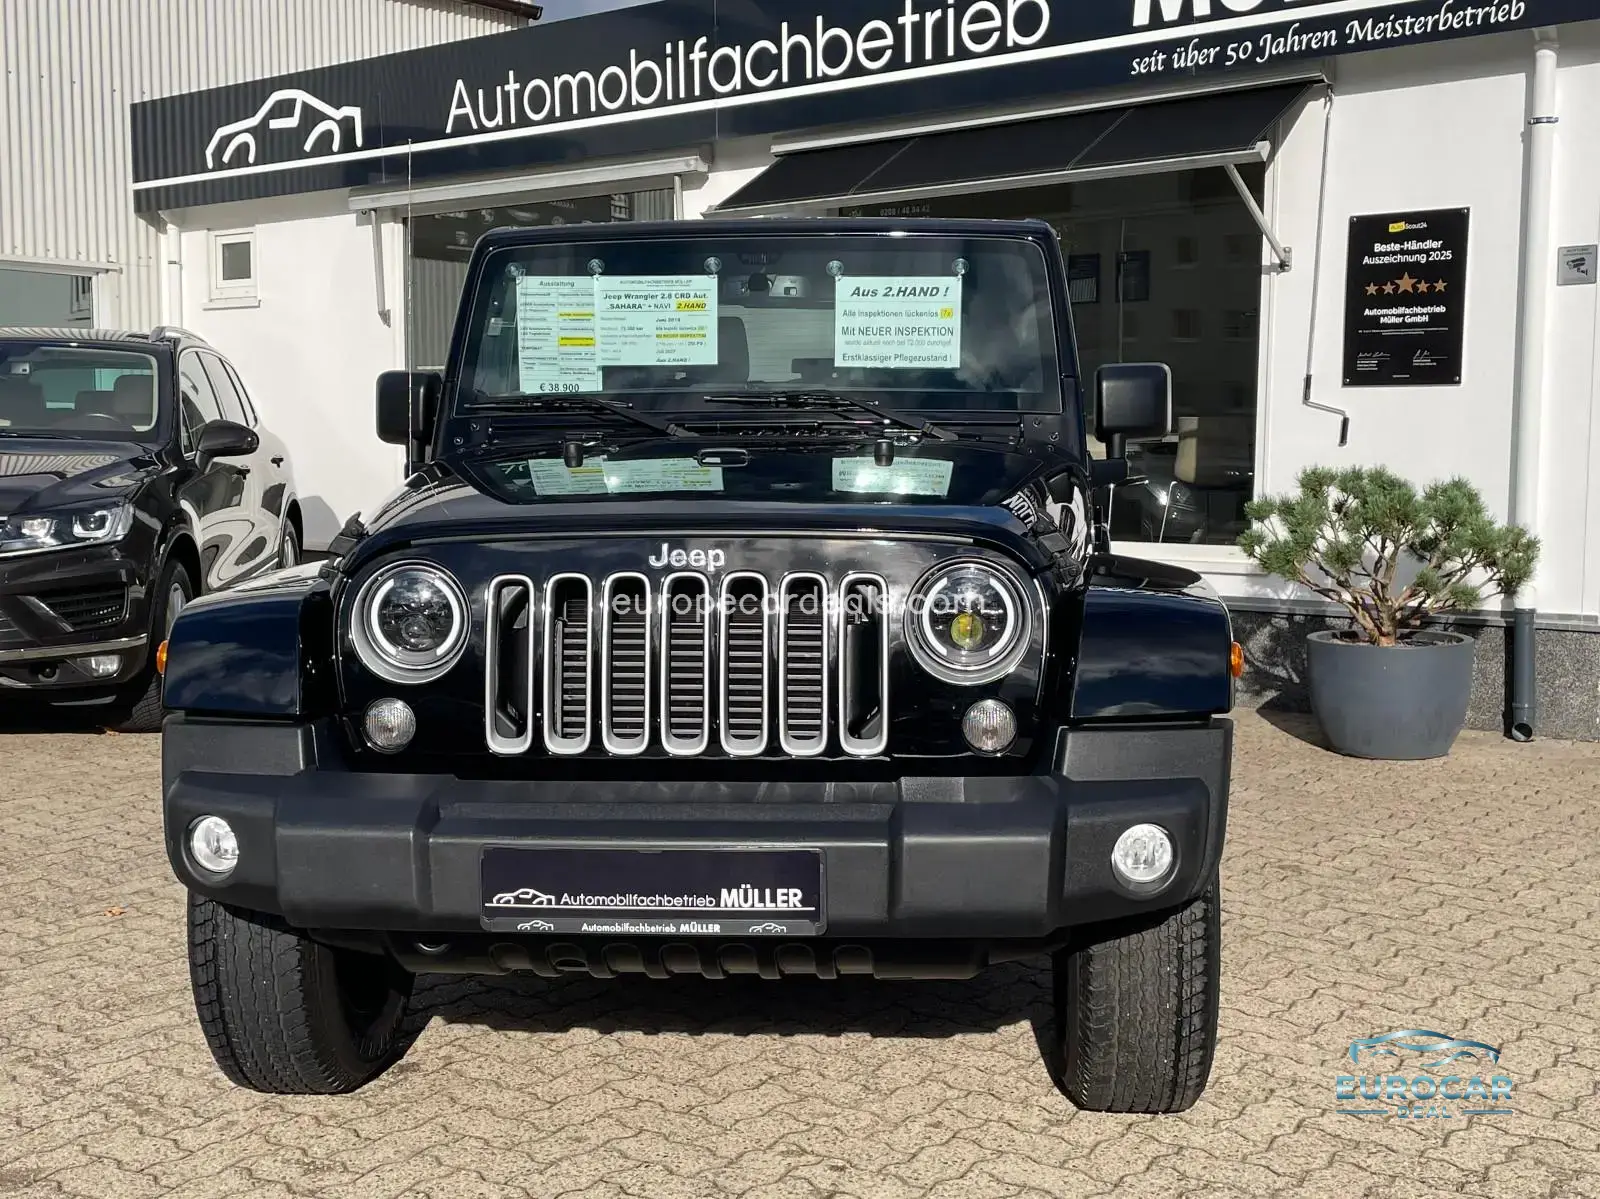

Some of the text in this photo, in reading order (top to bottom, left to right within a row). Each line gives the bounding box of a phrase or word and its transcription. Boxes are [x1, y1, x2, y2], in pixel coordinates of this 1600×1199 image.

[1130, 49, 1167, 75] seit
[1172, 38, 1221, 69] über
[1225, 40, 1252, 66] 50
[1255, 22, 1338, 64] Jahren
[1345, 0, 1526, 45] Meisterbetrieb
[445, 0, 1051, 134] Automobilfachbetrieb
[1373, 239, 1443, 253] Beste-Händler
[1362, 250, 1453, 265] Auszeichnung 2025
[603, 293, 623, 301] Jeep
[850, 286, 950, 298] Aus 2.HAND !
[842, 309, 856, 317] Alle
[904, 309, 938, 317] lückenlos
[1363, 305, 1446, 316] Automobilfachbetrieb
[1380, 314, 1429, 324] Müller GmbH
[841, 326, 954, 336] Mit NEUER INSPEKTION
[842, 353, 892, 363] Erstklassiger
[893, 353, 948, 363] Pflegezustand
[539, 382, 580, 393] € 38.900
[648, 542, 726, 572] Jeep
[560, 884, 803, 909] Automobilfachbetrieb MÜLLER
[581, 921, 721, 933] Automobilfachbetrieb MÜLLER
